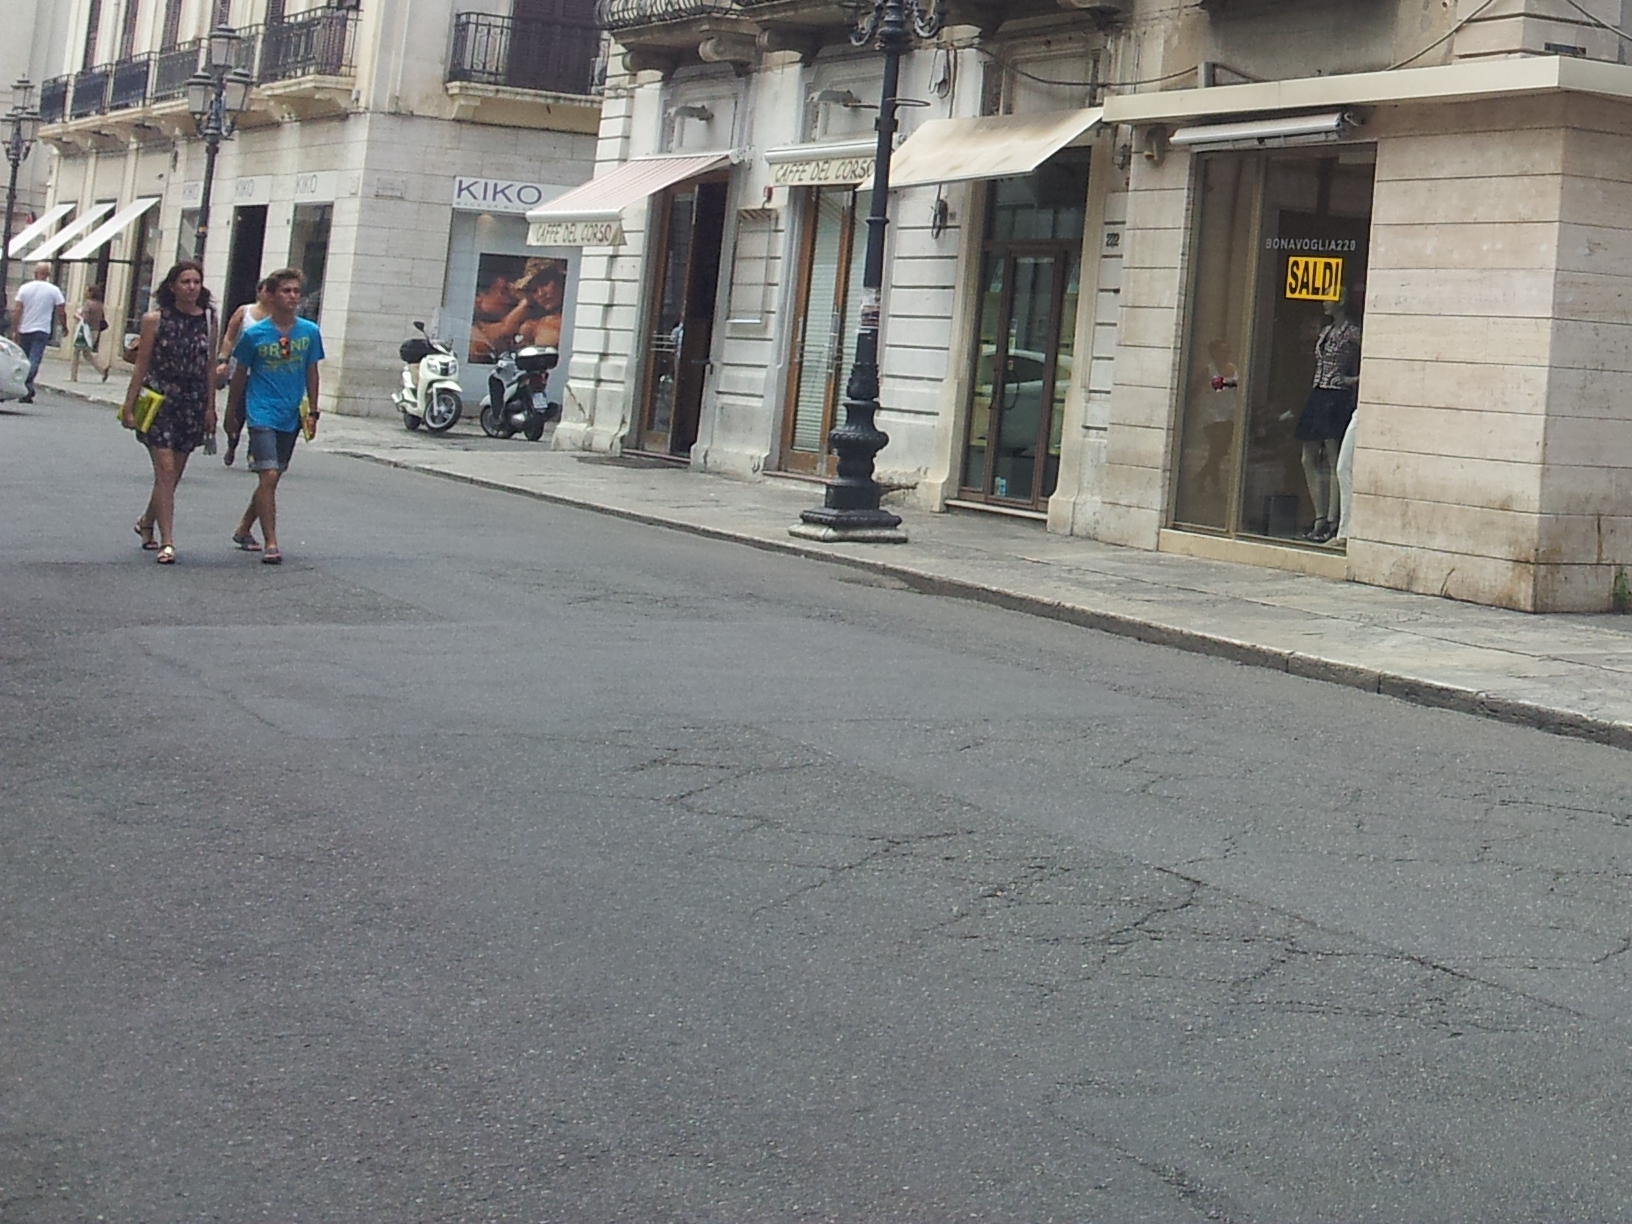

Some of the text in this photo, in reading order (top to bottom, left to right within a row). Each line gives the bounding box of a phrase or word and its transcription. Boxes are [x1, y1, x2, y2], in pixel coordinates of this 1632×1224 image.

[810, 160, 832, 181] DEL
[835, 158, 876, 180] CORSO
[296, 174, 318, 195] KIKO
[456, 179, 542, 205] KIKO
[562, 224, 577, 242] DEL
[581, 223, 611, 243] CORSO
[1265, 238, 1356, 251] BONAVOGLIA220
[1288, 260, 1340, 297] SALDI
[258, 337, 310, 358] BRND
